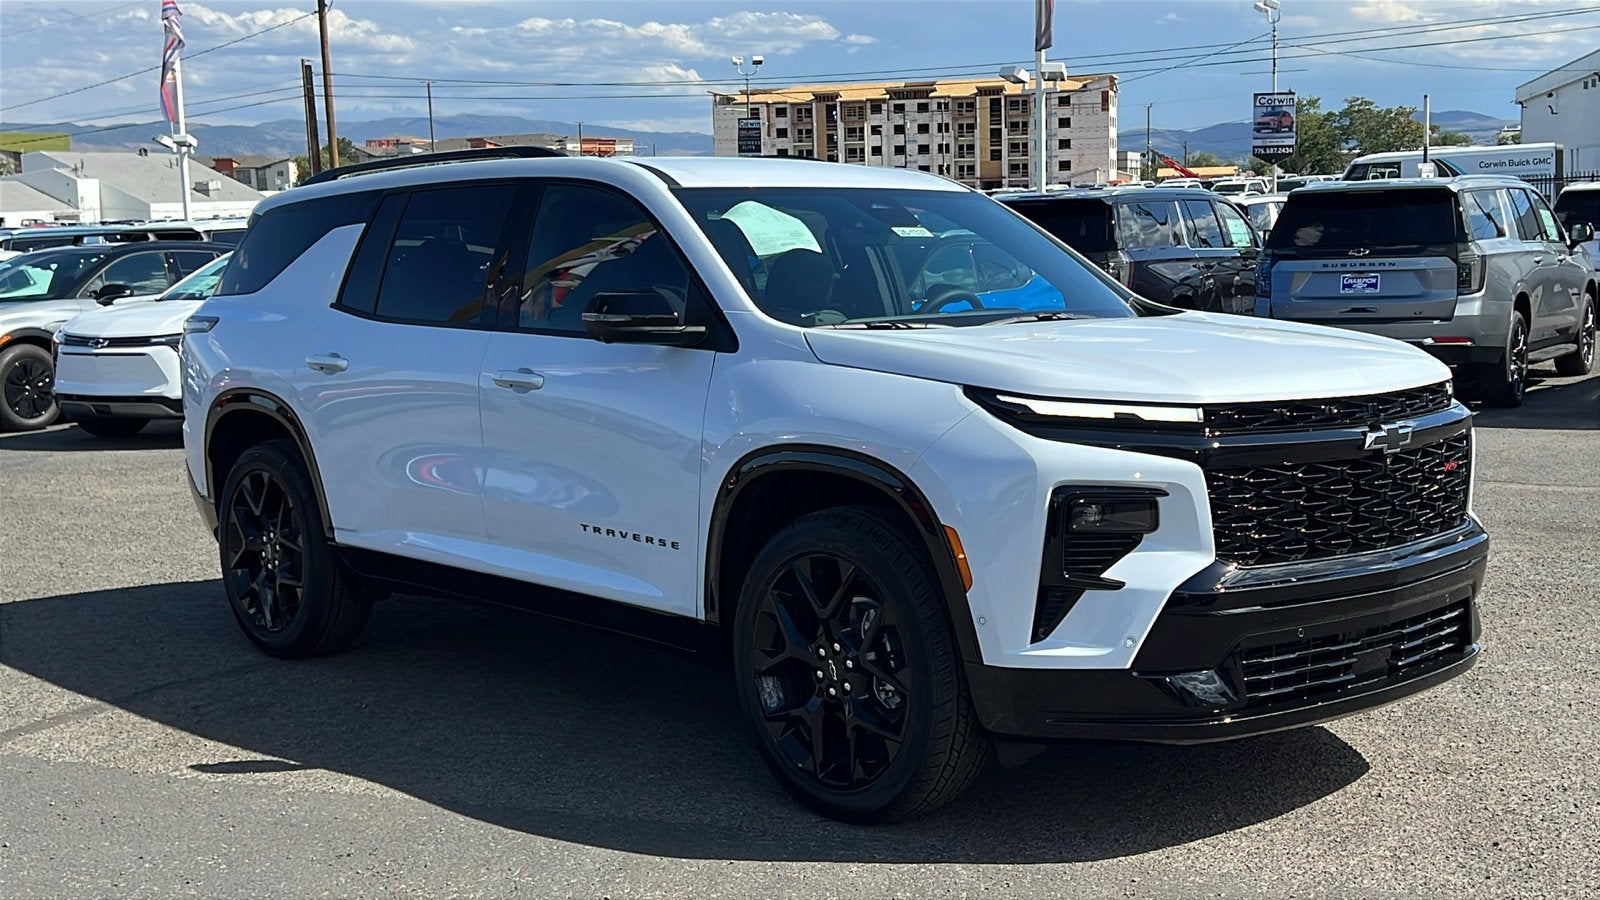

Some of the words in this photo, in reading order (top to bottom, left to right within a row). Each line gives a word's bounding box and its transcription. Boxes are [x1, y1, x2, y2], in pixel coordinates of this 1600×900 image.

[1258, 96, 1294, 105] Corwin
[1479, 160, 1507, 168] Corwin
[1508, 159, 1531, 167] Buick
[1532, 157, 1552, 166] GMC
[580, 523, 680, 550] TRAVERSE
